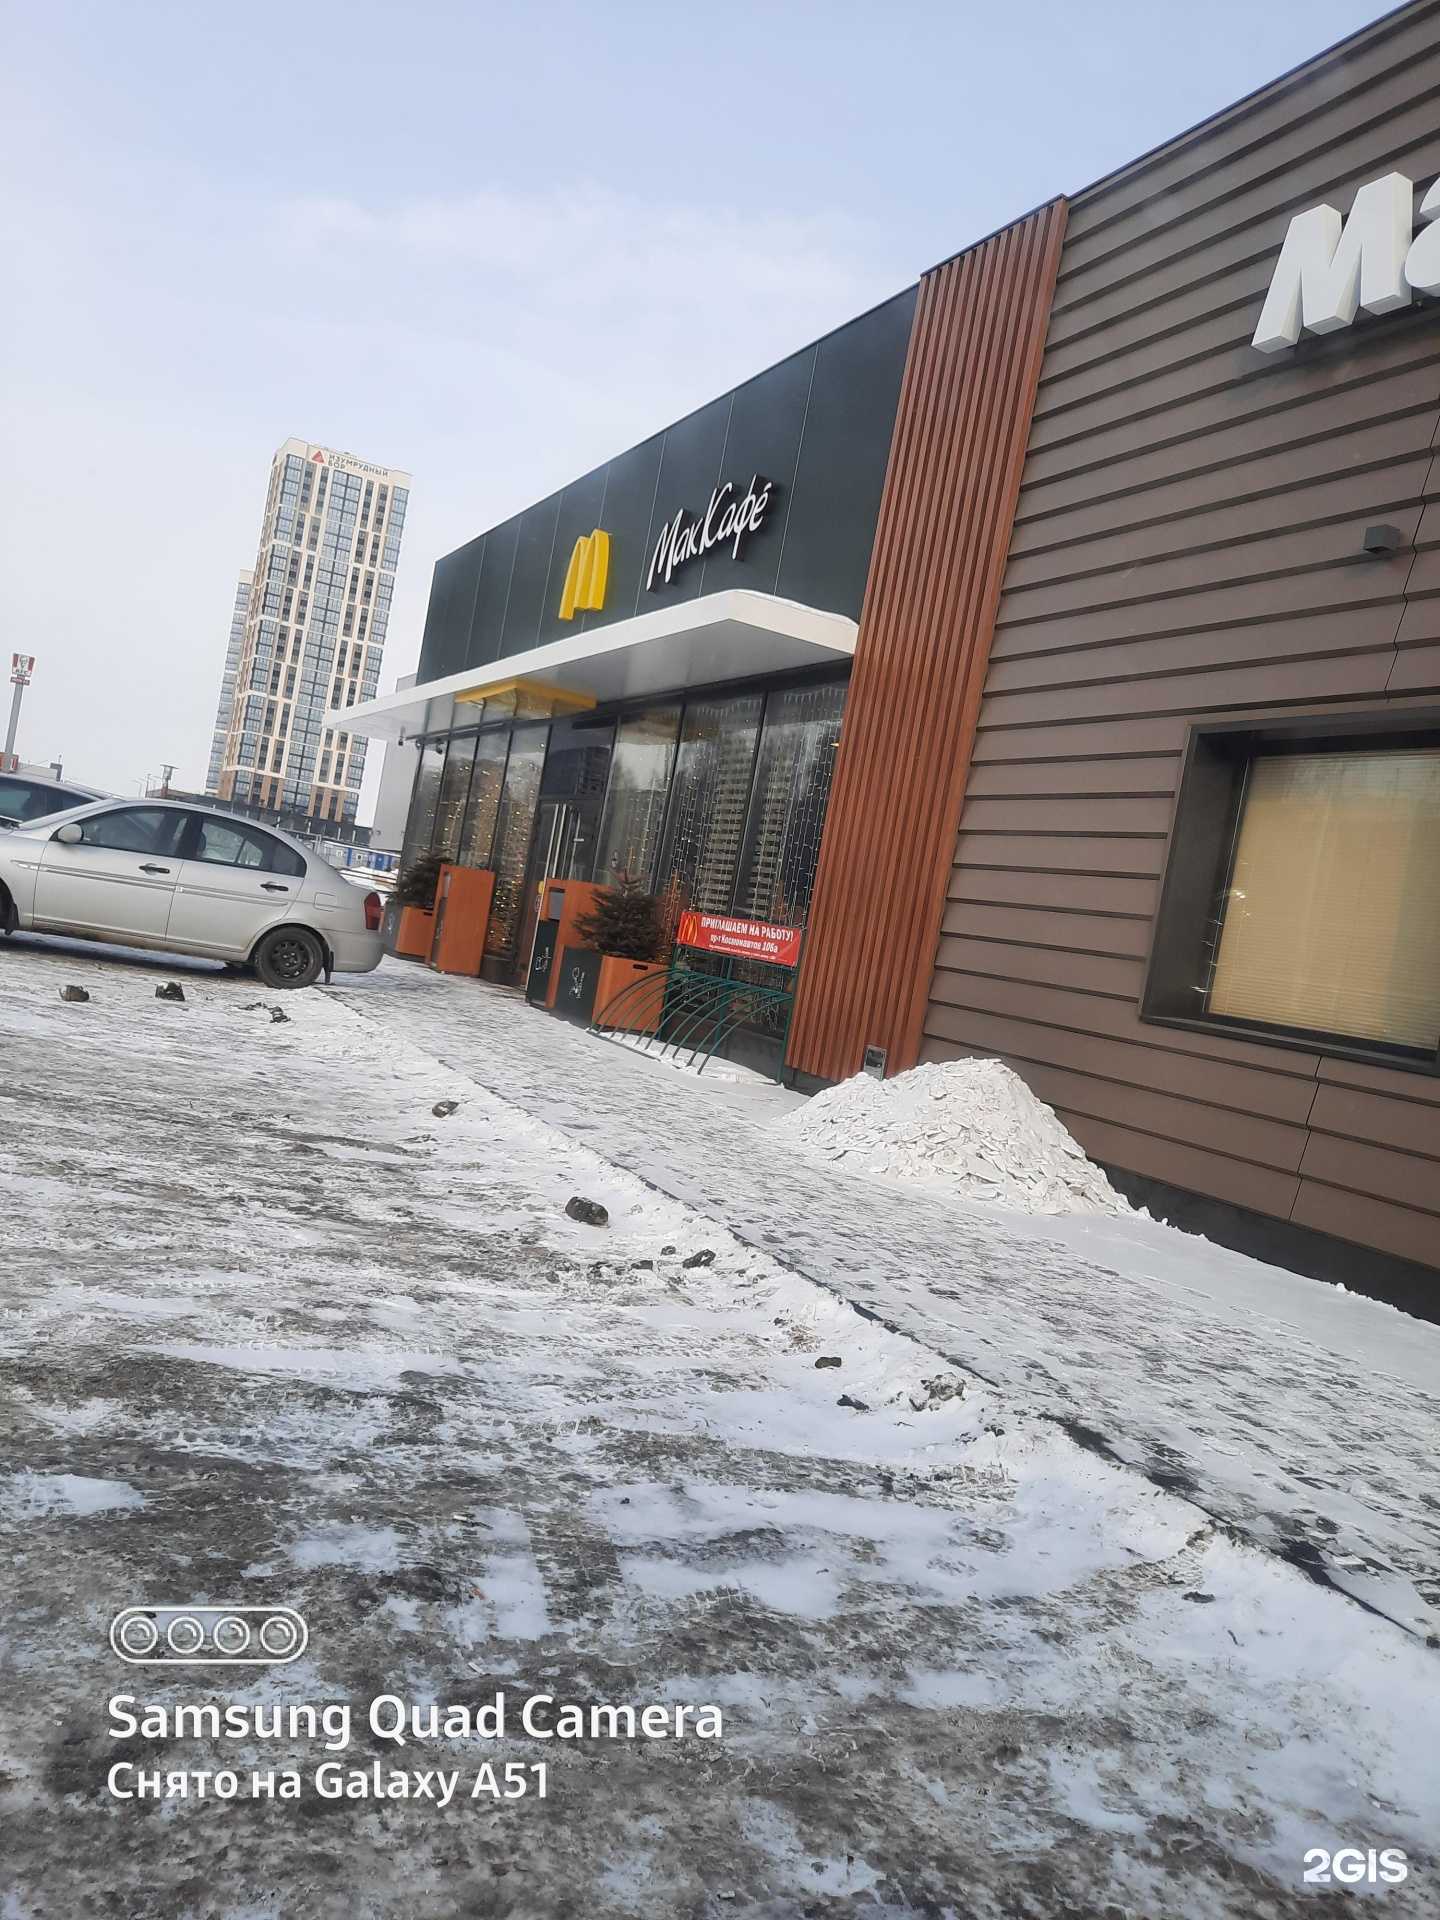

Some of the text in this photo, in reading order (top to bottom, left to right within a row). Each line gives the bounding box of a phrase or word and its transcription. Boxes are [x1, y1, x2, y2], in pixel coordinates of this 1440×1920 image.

[701, 916, 794, 942] ПРИГЛАШАЕМ НА РАБОТУ!
